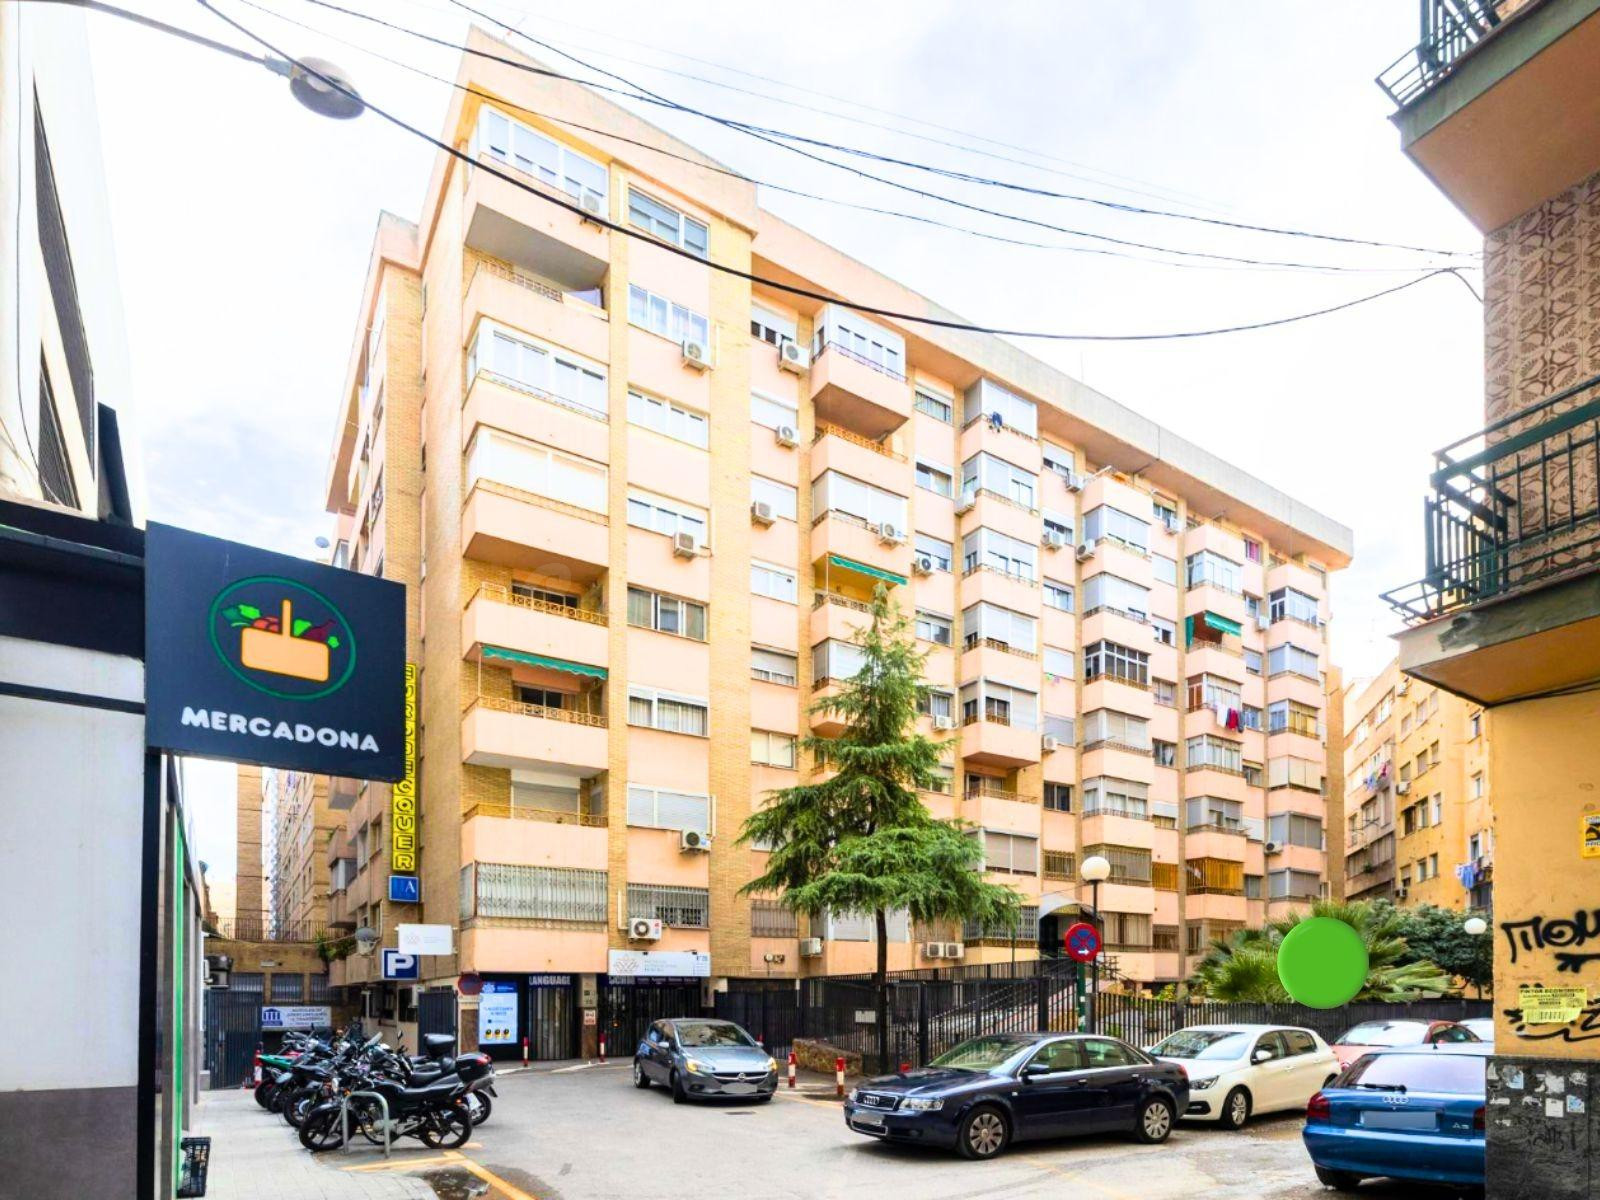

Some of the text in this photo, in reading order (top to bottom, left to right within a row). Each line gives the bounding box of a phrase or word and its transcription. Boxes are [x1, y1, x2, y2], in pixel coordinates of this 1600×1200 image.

[181, 706, 380, 753] MERCADONA
[387, 952, 415, 976] P
[528, 975, 571, 986] LANGUAGE
